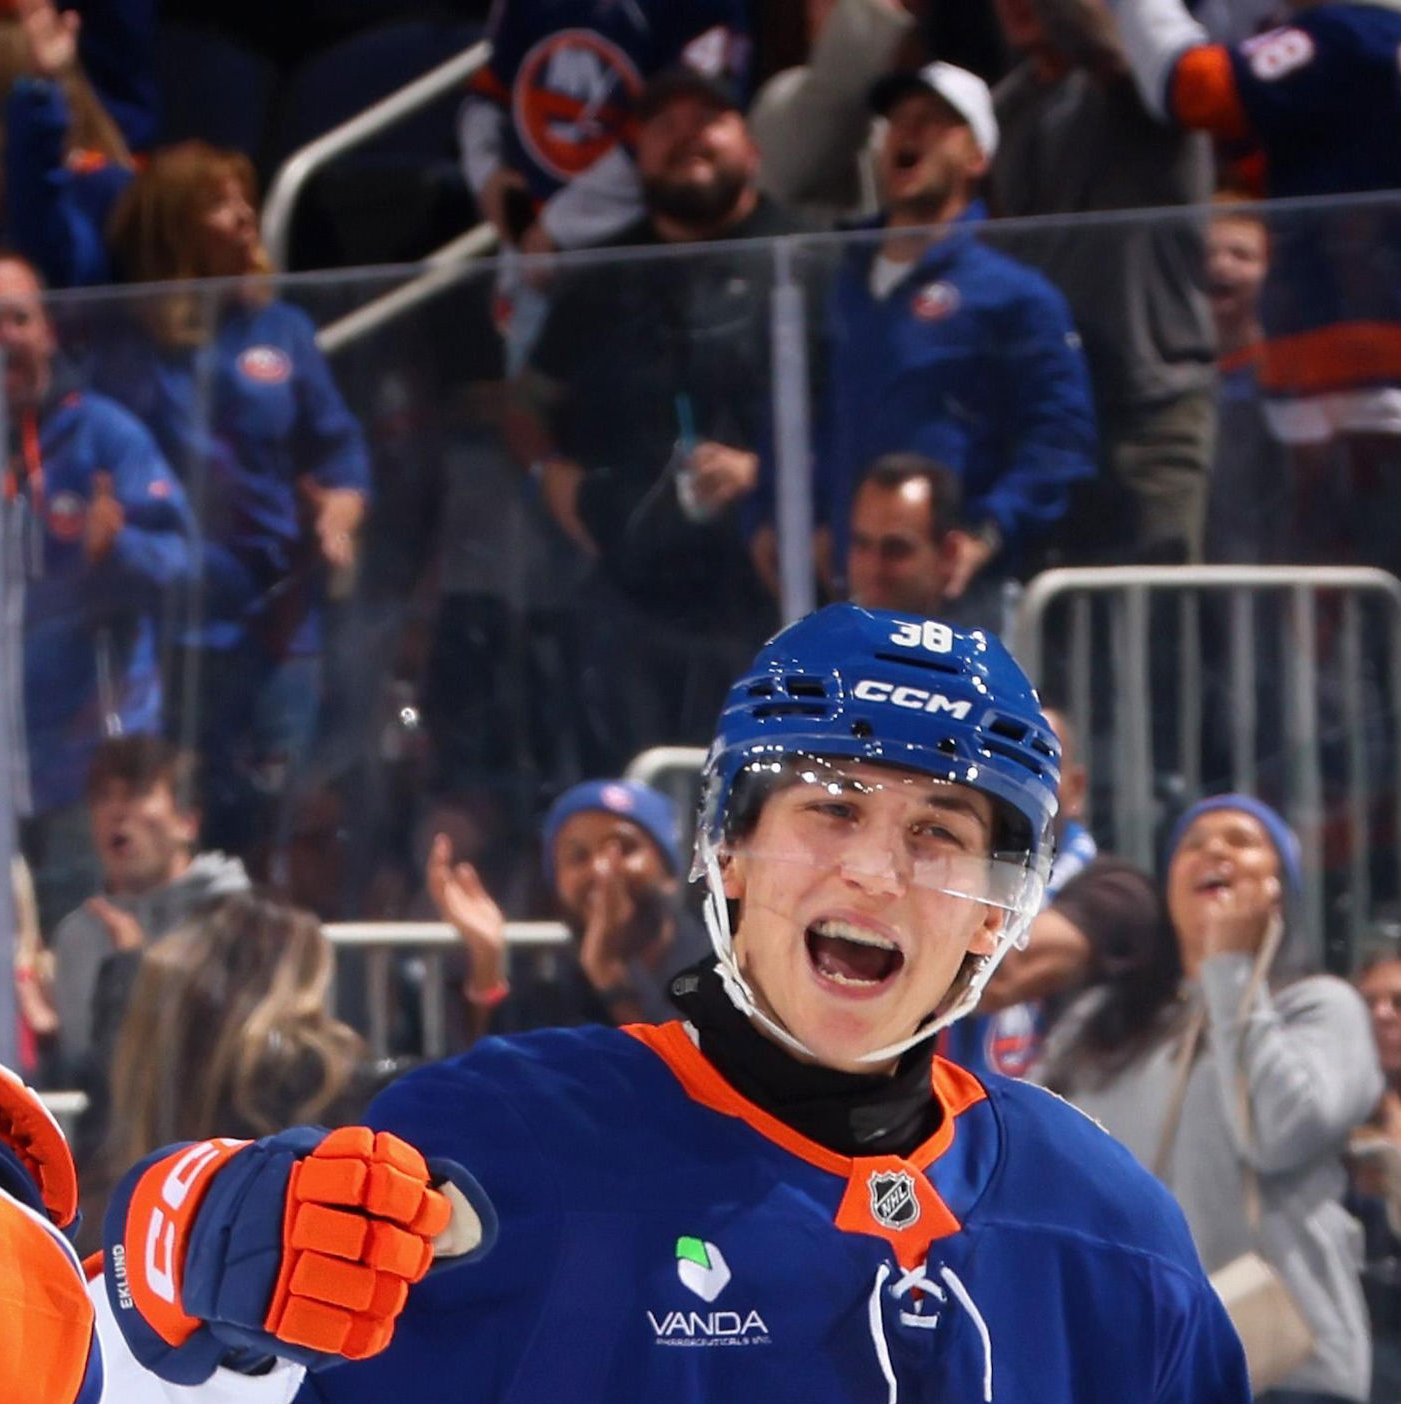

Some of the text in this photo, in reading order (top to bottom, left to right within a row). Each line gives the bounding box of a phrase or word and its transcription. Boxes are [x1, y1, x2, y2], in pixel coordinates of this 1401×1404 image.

[889, 619, 953, 653] 38
[854, 680, 973, 720] CCM
[145, 1137, 254, 1304] CC
[881, 1186, 908, 1218] NHL
[112, 1244, 134, 1310] EKLUND
[647, 1310, 769, 1336] VANDA
